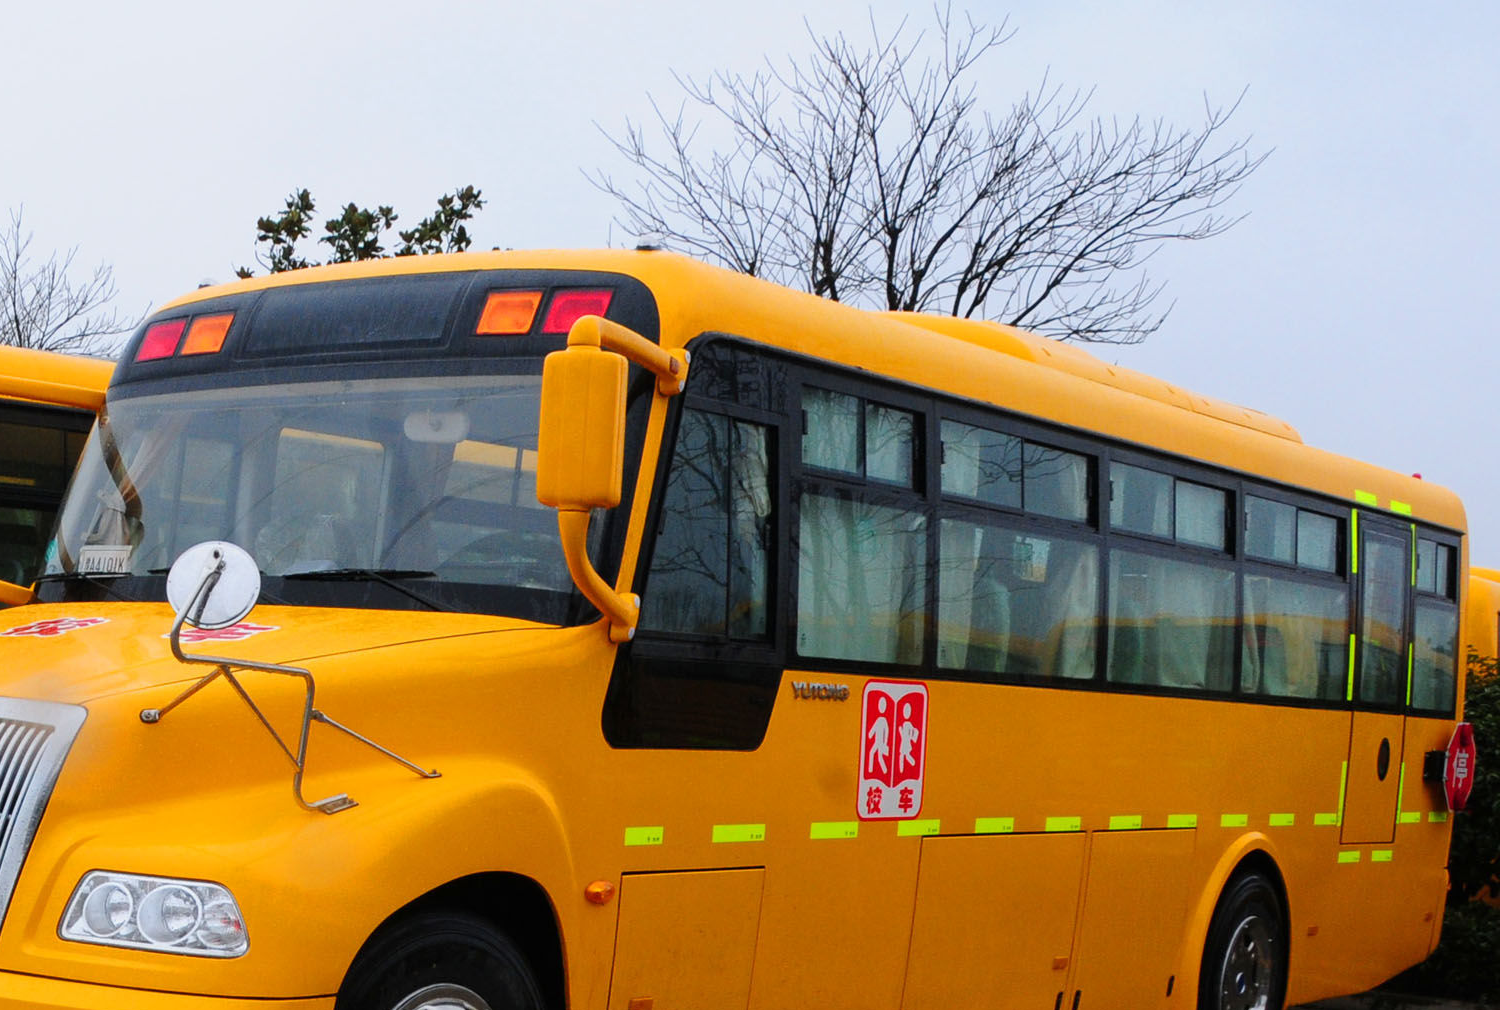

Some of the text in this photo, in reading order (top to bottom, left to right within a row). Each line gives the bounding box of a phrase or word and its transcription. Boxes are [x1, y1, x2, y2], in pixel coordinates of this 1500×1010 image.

[792, 681, 850, 701] YUTONG
[1452, 748, 1470, 788] 停
[866, 787, 913, 815] 校车
